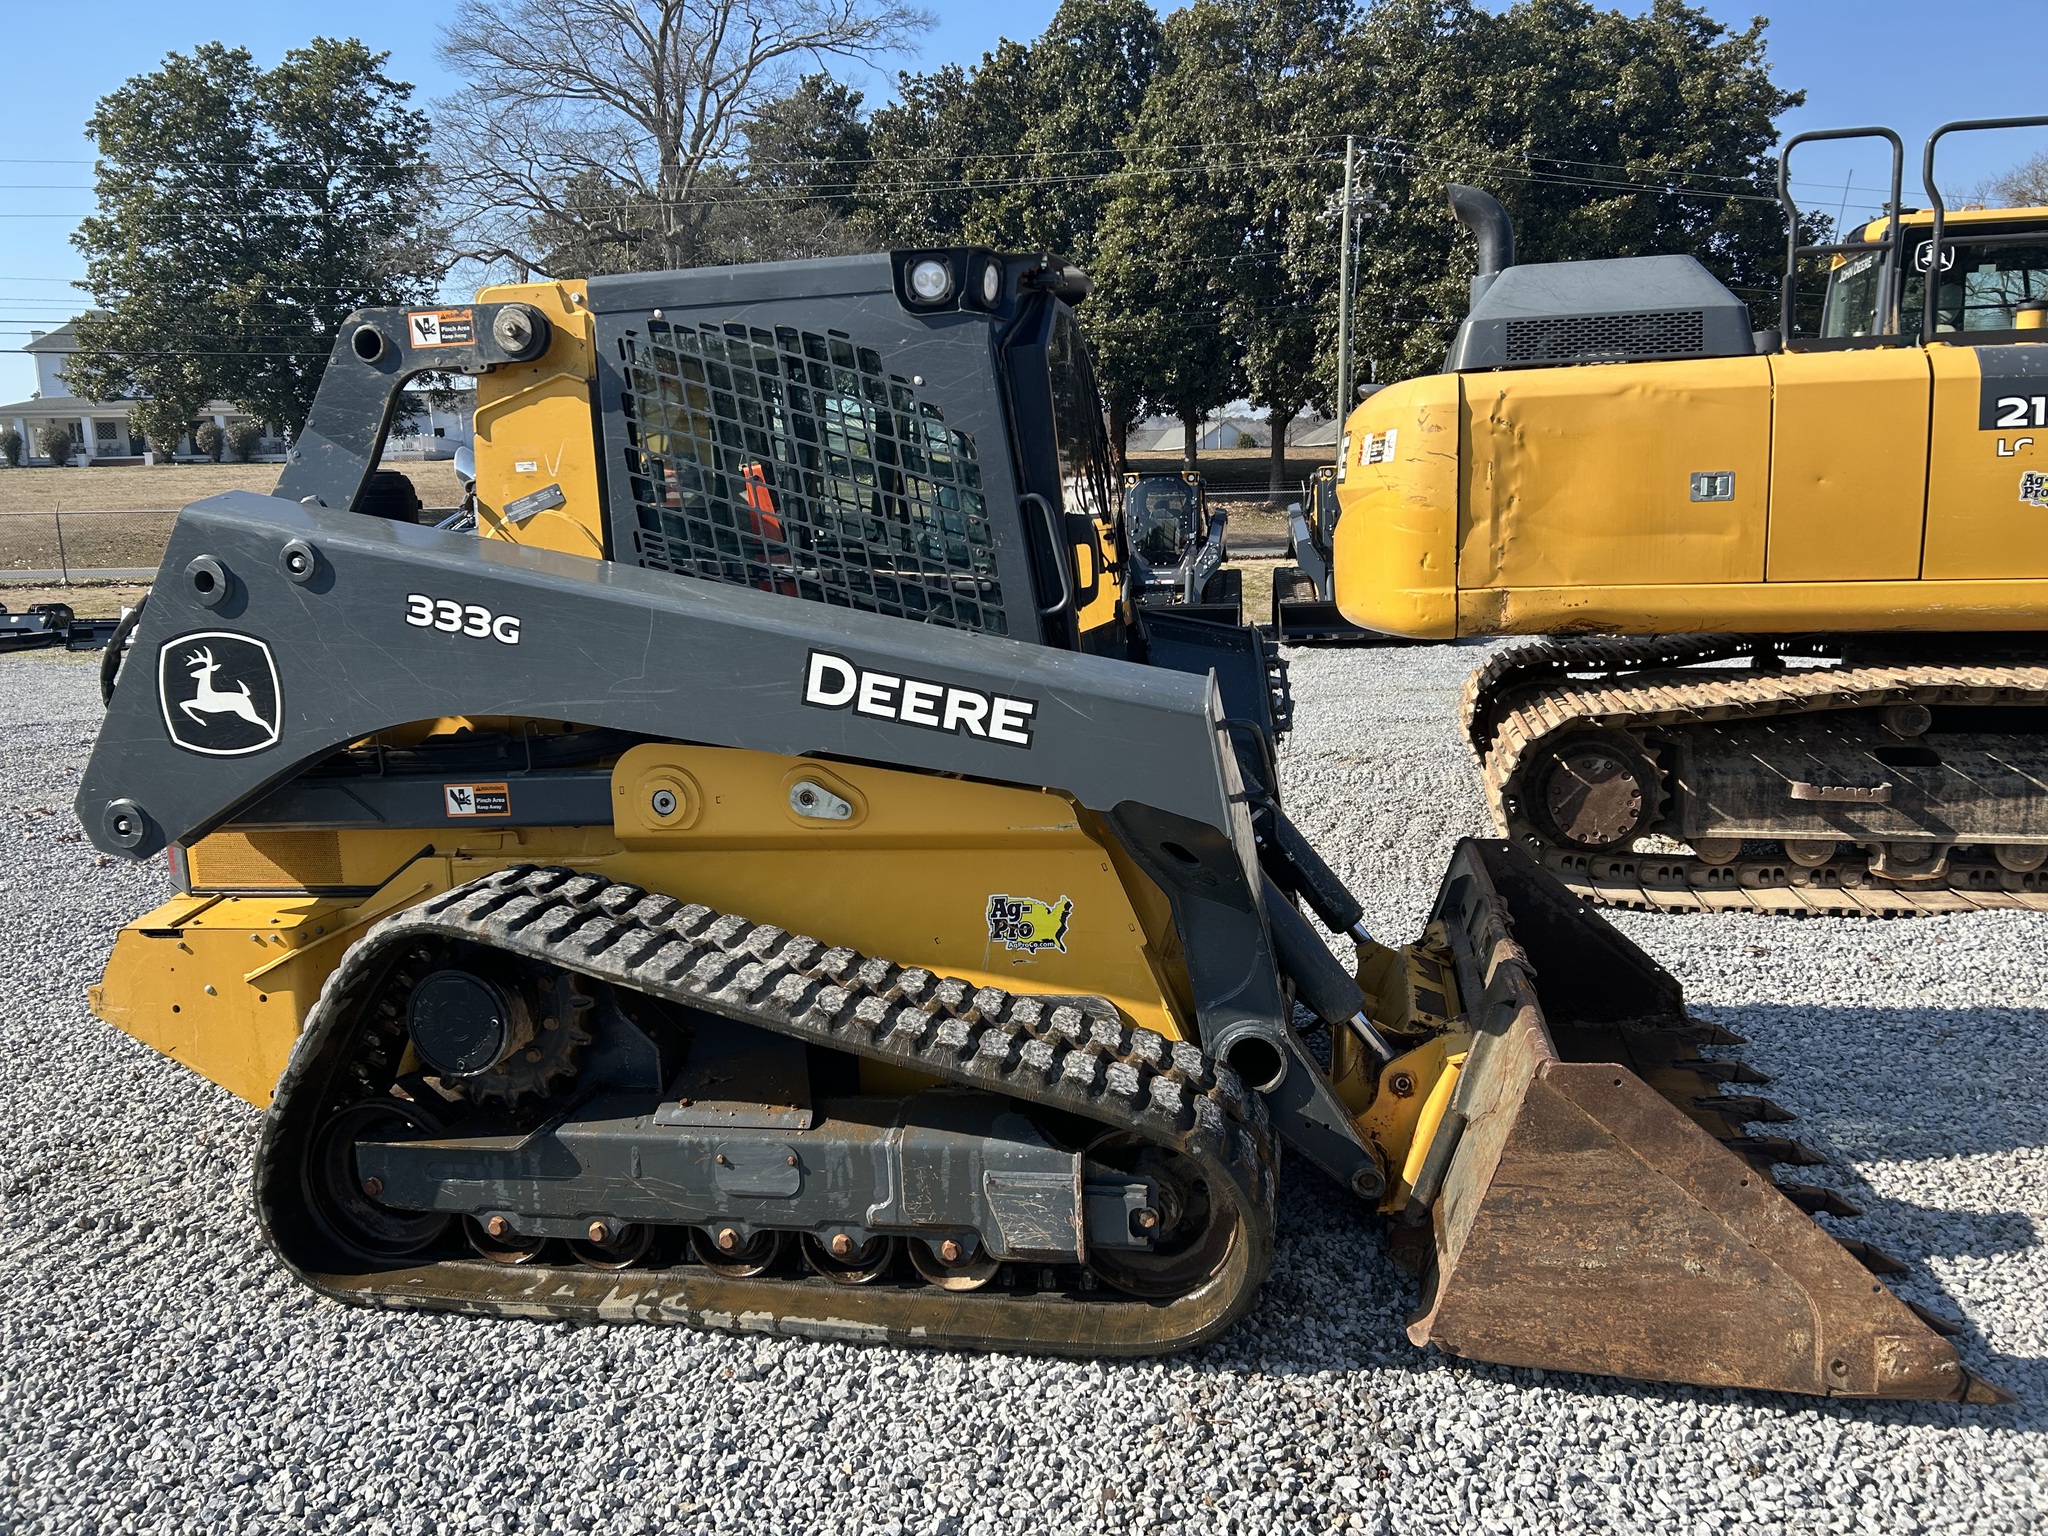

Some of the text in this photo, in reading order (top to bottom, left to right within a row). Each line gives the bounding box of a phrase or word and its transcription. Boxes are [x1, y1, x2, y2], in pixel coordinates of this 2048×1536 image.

[1853, 256, 1873, 275] DEERE
[2023, 487, 2048, 498] Pro
[406, 593, 520, 644] 333G
[805, 651, 1034, 746] DEERE
[991, 898, 1031, 922] Ag-
[992, 920, 1033, 939] Pro
[1008, 941, 1055, 949] AgProCo.com
